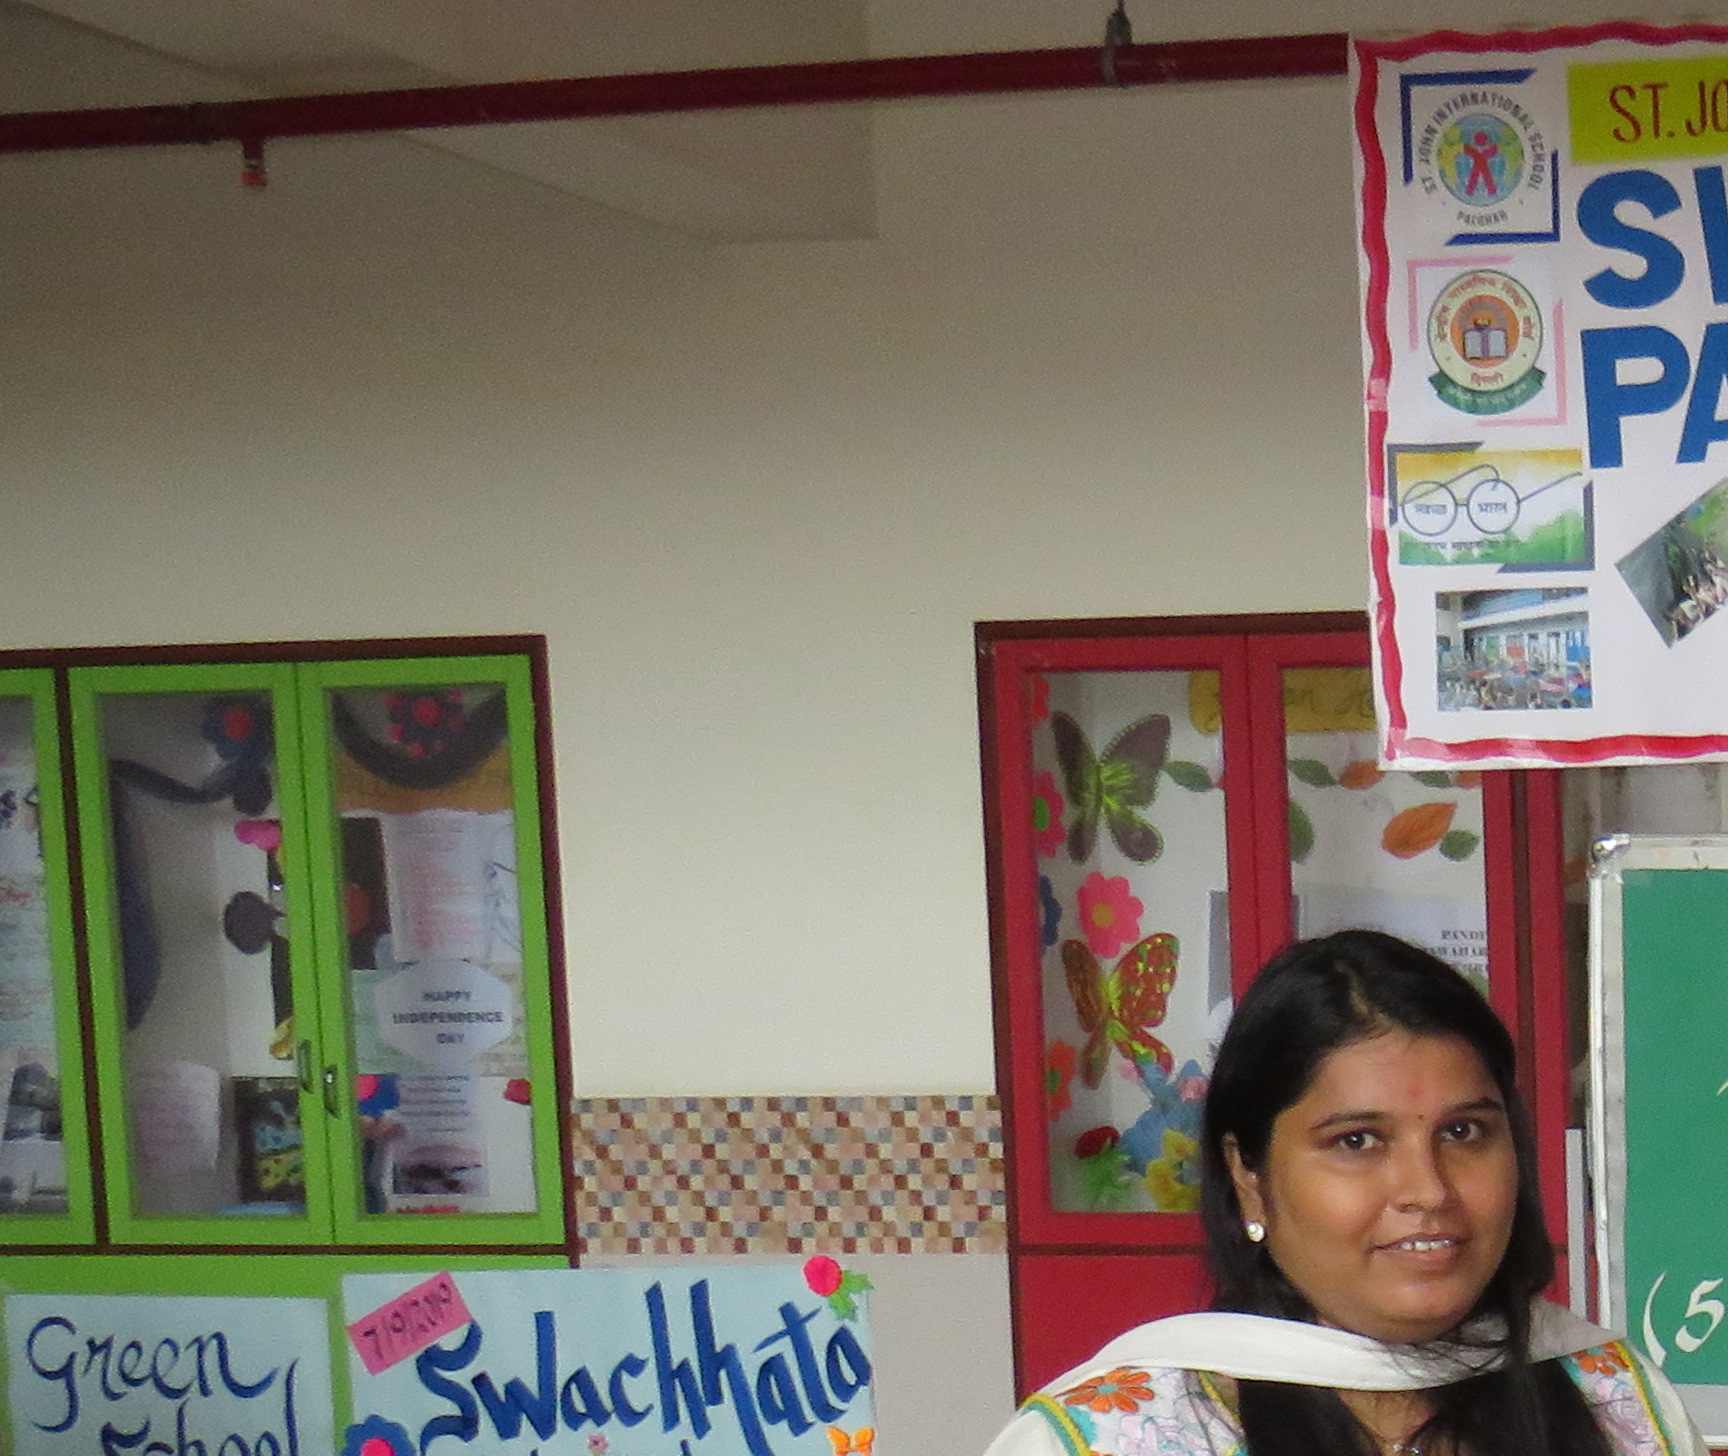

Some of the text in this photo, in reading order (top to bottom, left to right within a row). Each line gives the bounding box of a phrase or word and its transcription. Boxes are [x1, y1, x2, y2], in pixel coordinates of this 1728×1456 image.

[1432, 90, 1535, 131] INTERNATIONAL
[1609, 82, 1675, 142] ST.
[421, 990, 471, 1001] HAPPY
[392, 1011, 503, 1024] INDEPENDENCE
[27, 1316, 281, 1434] Green
